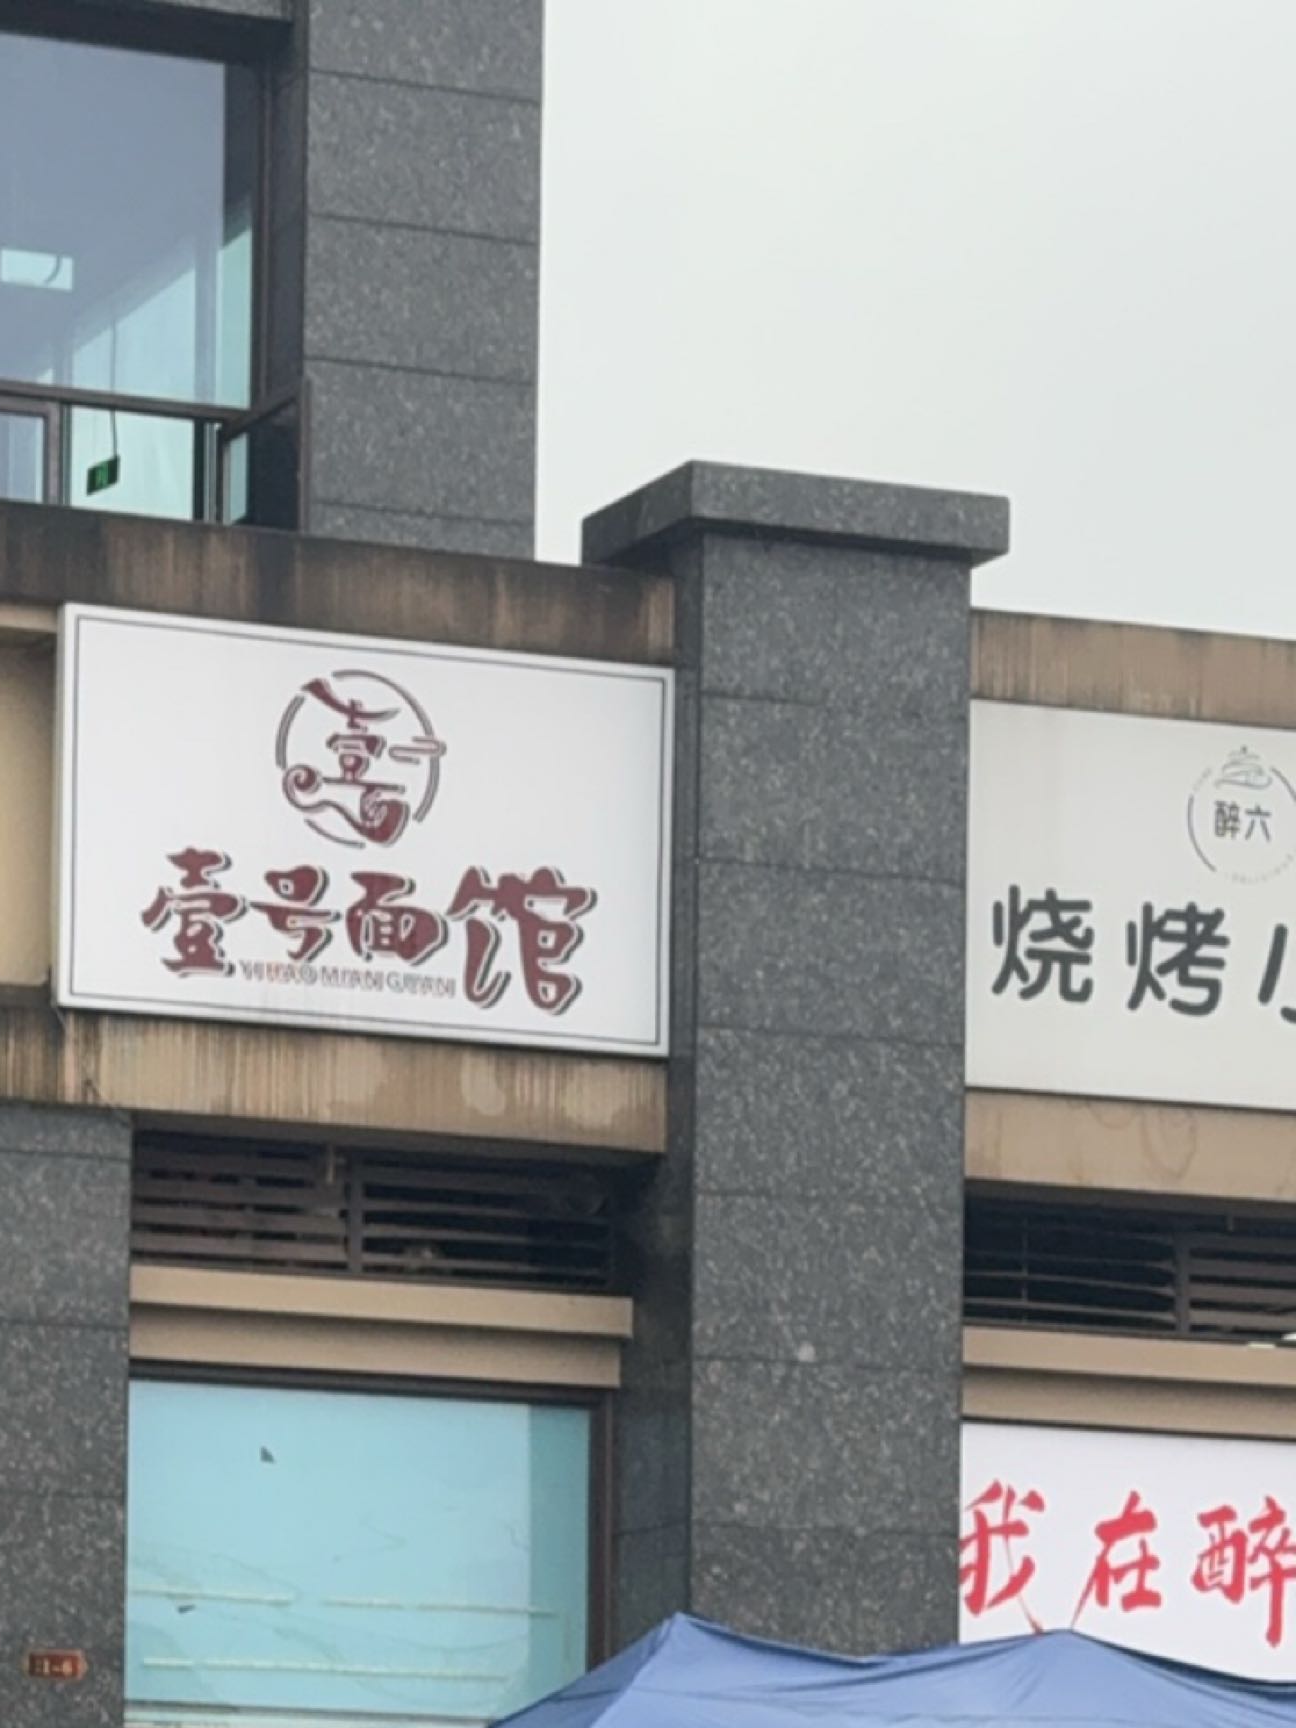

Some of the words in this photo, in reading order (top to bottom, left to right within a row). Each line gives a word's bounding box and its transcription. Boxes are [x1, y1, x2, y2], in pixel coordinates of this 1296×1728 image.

[1214, 800, 1272, 842] 醉六
[141, 847, 597, 1016] 壹号面馆
[959, 1480, 1296, 1649] 我在醉
